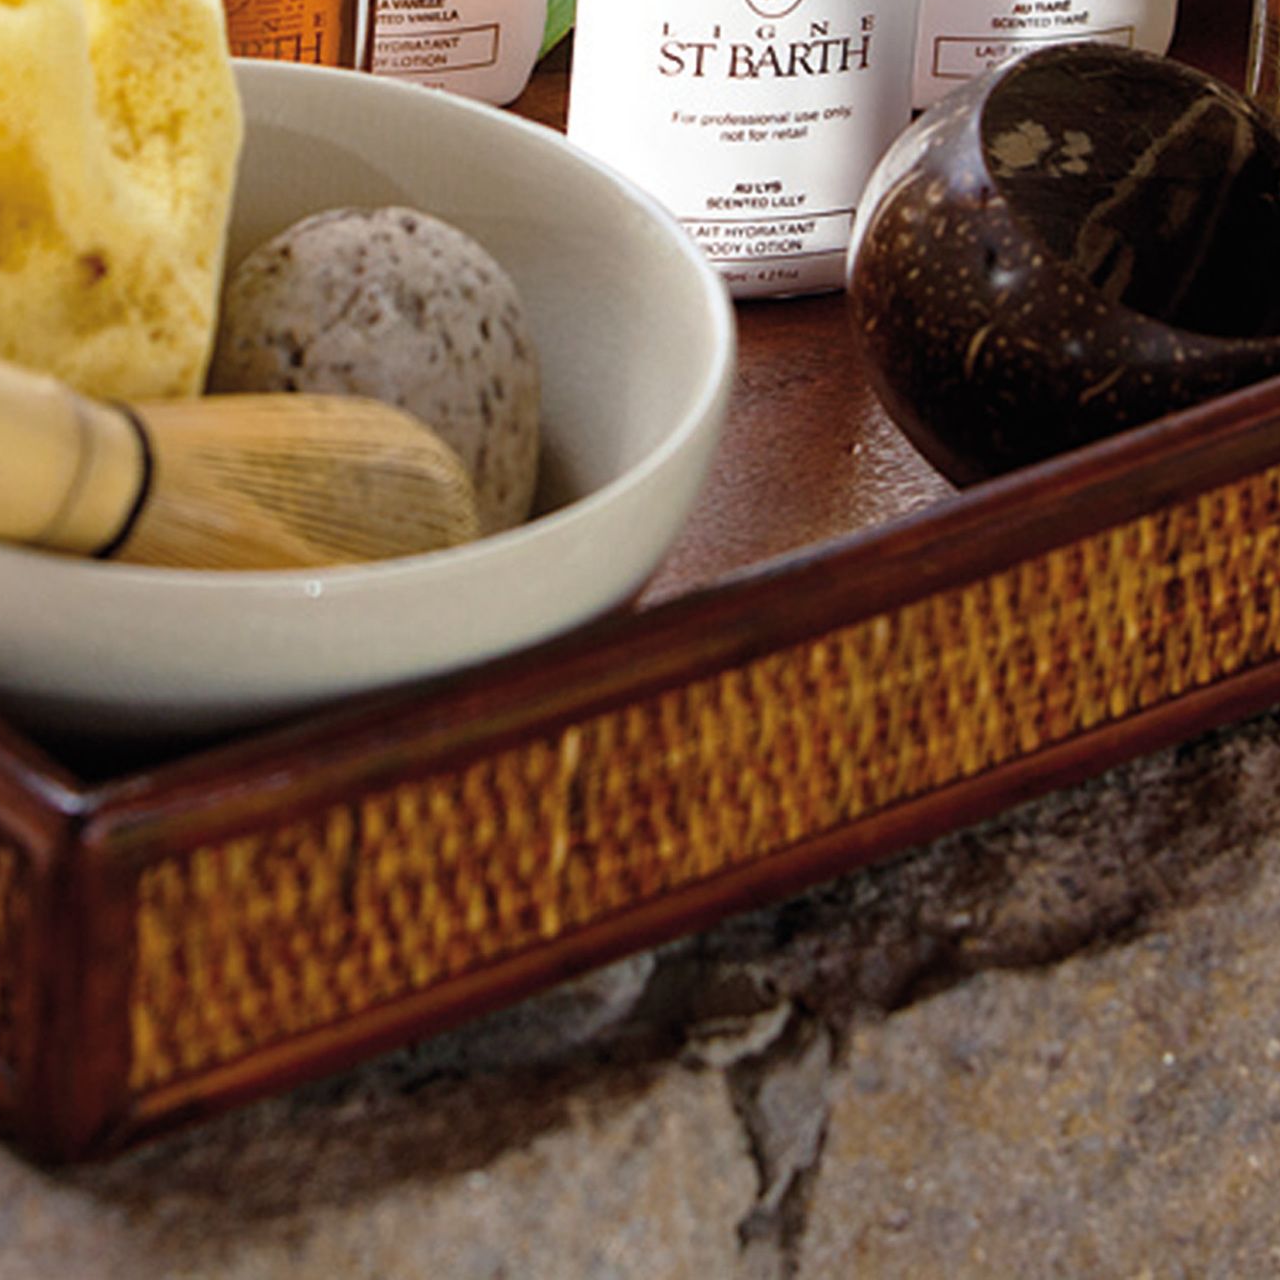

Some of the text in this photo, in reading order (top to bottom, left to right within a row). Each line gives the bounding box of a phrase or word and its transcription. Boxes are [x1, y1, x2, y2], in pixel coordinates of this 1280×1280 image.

[1013, 4, 1032, 15] AU
[663, 15, 874, 41] LIGNE
[991, 17, 1051, 29] SCENTED
[658, 34, 872, 79] ST BARTH
[975, 45, 1006, 57] LAIT
[392, 54, 448, 68] LOTION
[672, 110, 696, 123] For
[700, 110, 791, 126] professional
[794, 110, 819, 123] use
[720, 125, 808, 142] not for retail
[733, 181, 753, 194] AU
[706, 197, 769, 209] SCENTED
[725, 221, 815, 238] HYDRATANT
[746, 239, 803, 256] LOTION
